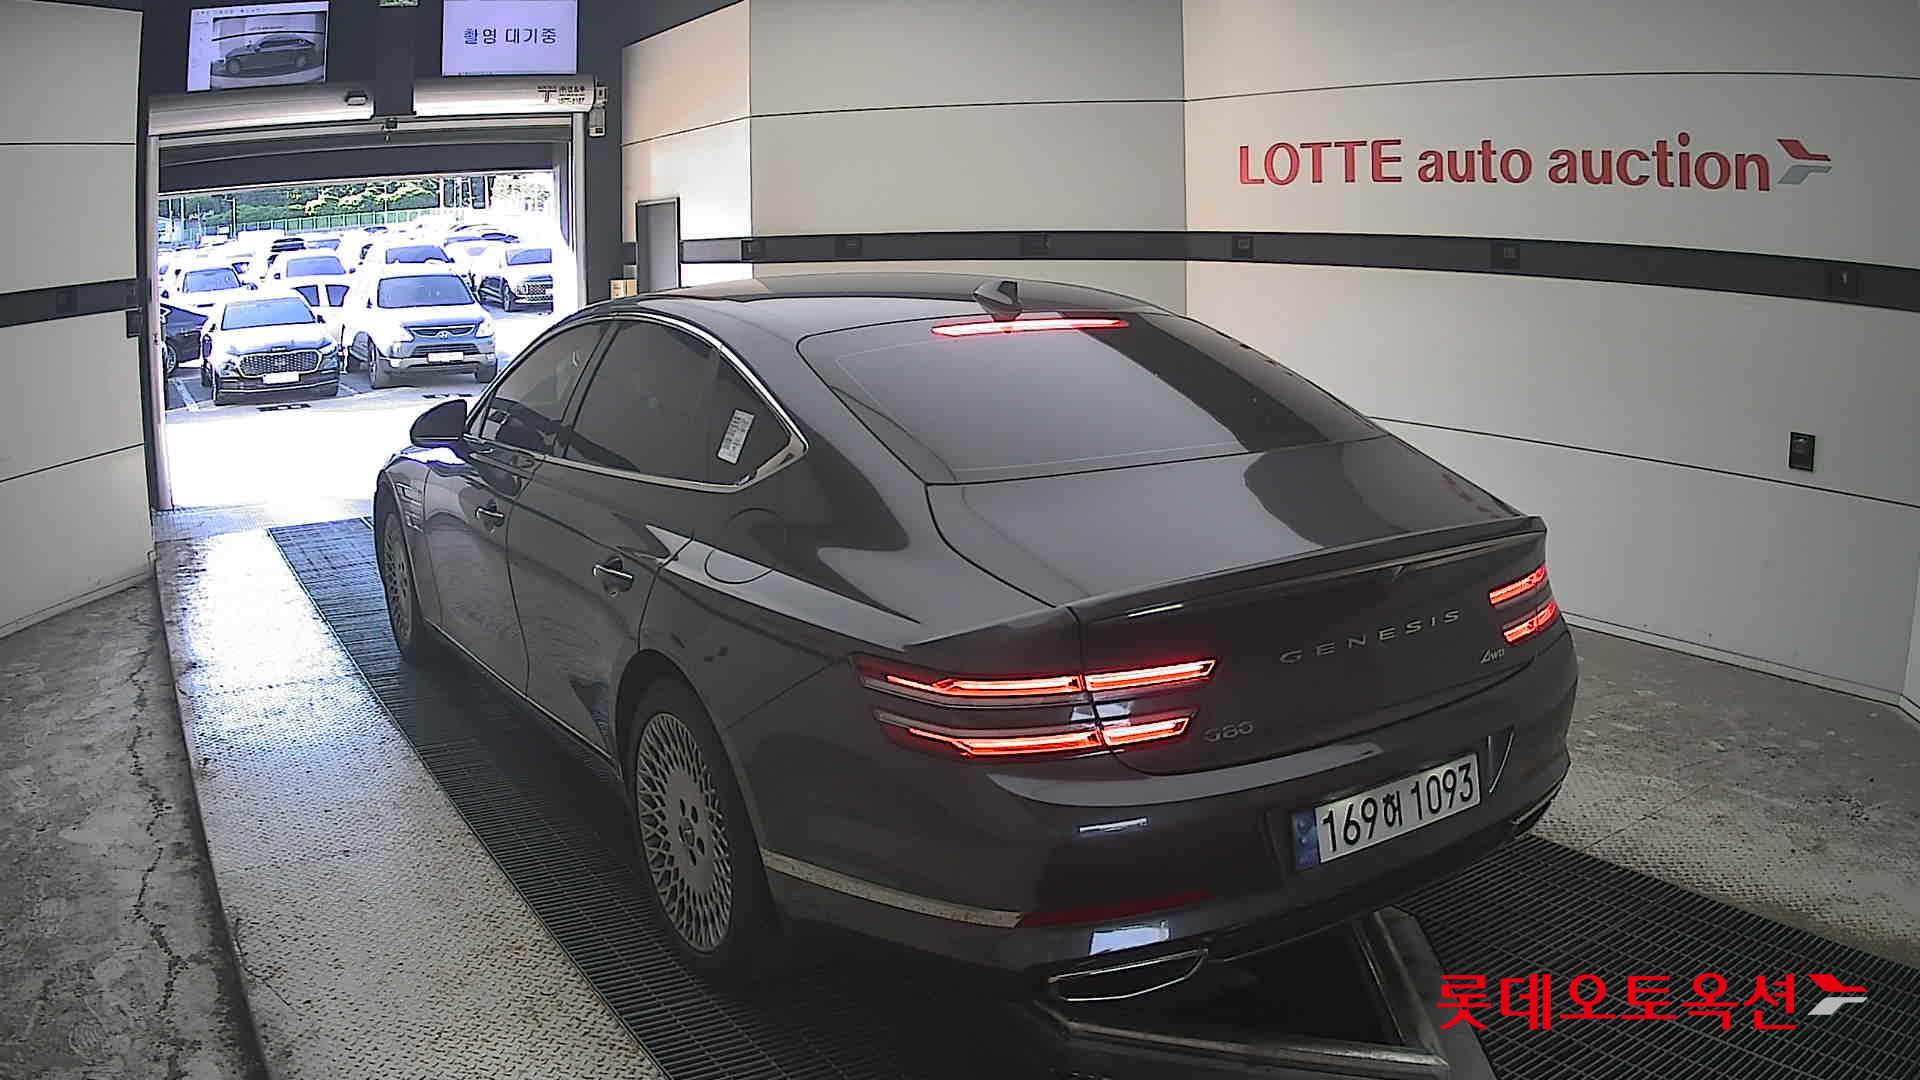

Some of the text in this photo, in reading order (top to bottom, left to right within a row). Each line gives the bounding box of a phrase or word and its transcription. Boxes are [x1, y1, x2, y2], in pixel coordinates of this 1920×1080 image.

[505, 28, 558, 45] 대기중
[1238, 132, 1772, 191] LOTTE auto auction
[1279, 609, 1460, 664] GENESIS
[1321, 762, 1474, 852] 169허 1093
